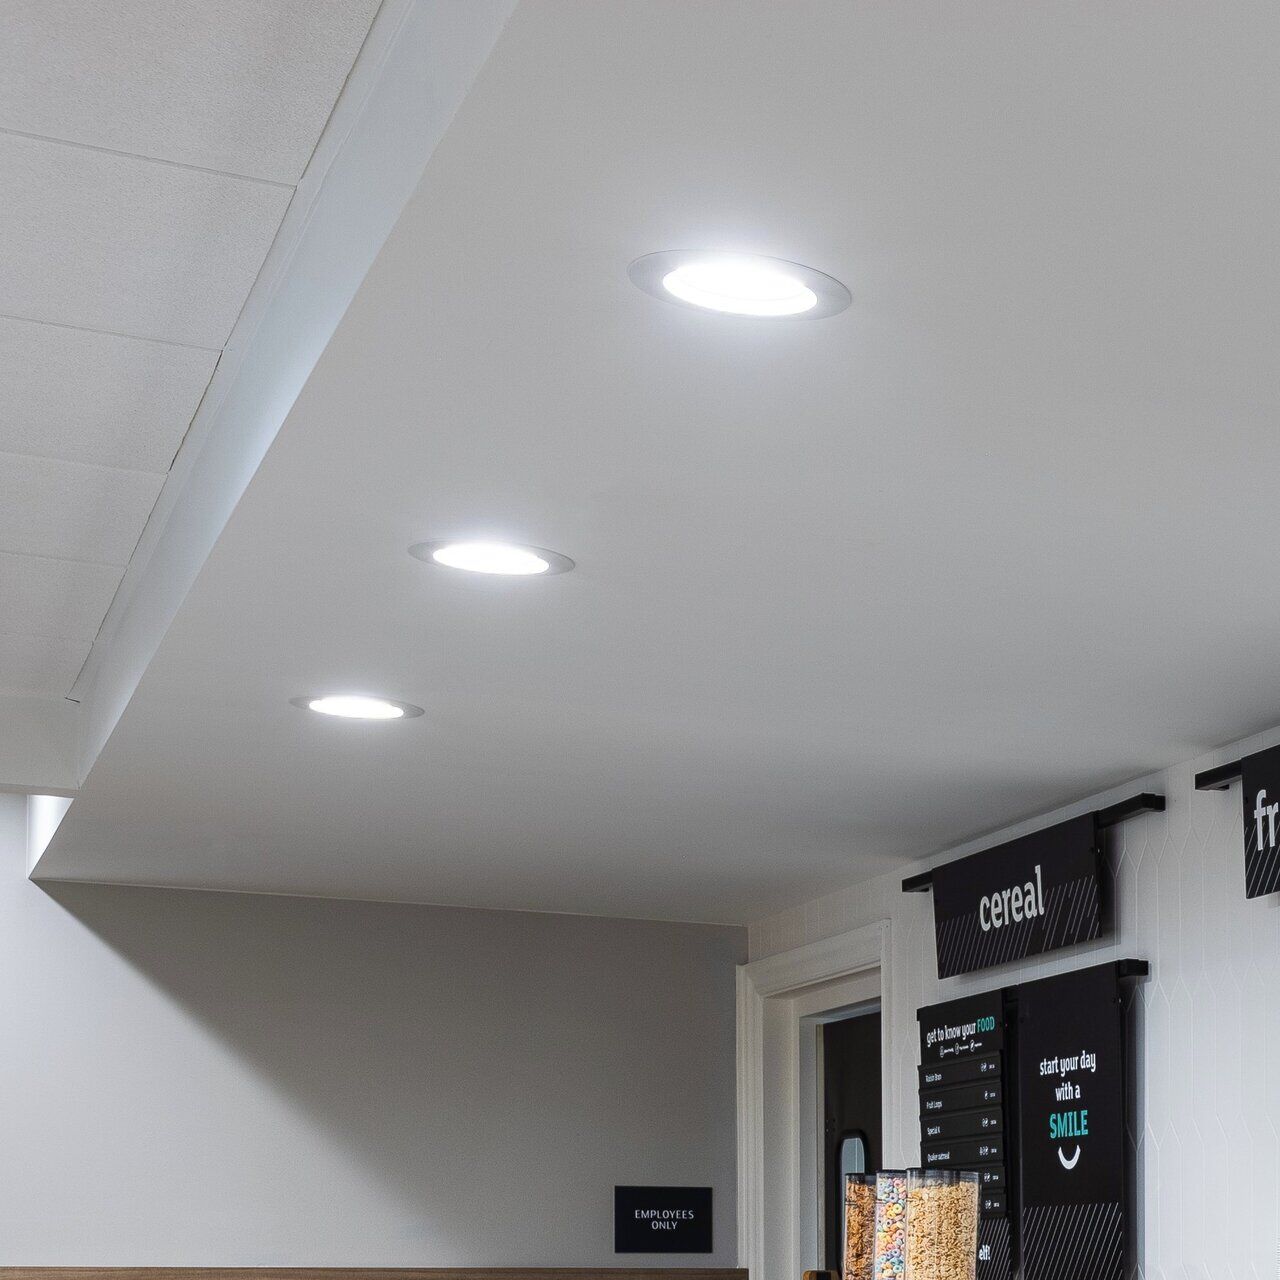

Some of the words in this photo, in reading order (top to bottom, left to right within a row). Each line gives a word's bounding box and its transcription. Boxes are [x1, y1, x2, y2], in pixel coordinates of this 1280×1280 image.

[980, 864, 1045, 932] cereal
[927, 1029, 937, 1048] get
[937, 1028, 944, 1041] to
[945, 1025, 961, 1040] know
[962, 1022, 976, 1040] your
[977, 1016, 995, 1033] FOOD
[1040, 1058, 1058, 1076] start
[1060, 1053, 1078, 1078] your
[1080, 1050, 1096, 1073] day
[1055, 1085, 1073, 1102] with
[1074, 1086, 1080, 1099] a
[1050, 1109, 1088, 1139] SMILE
[635, 1210, 694, 1219] EMPLOYEES
[651, 1221, 678, 1230] ONLY
